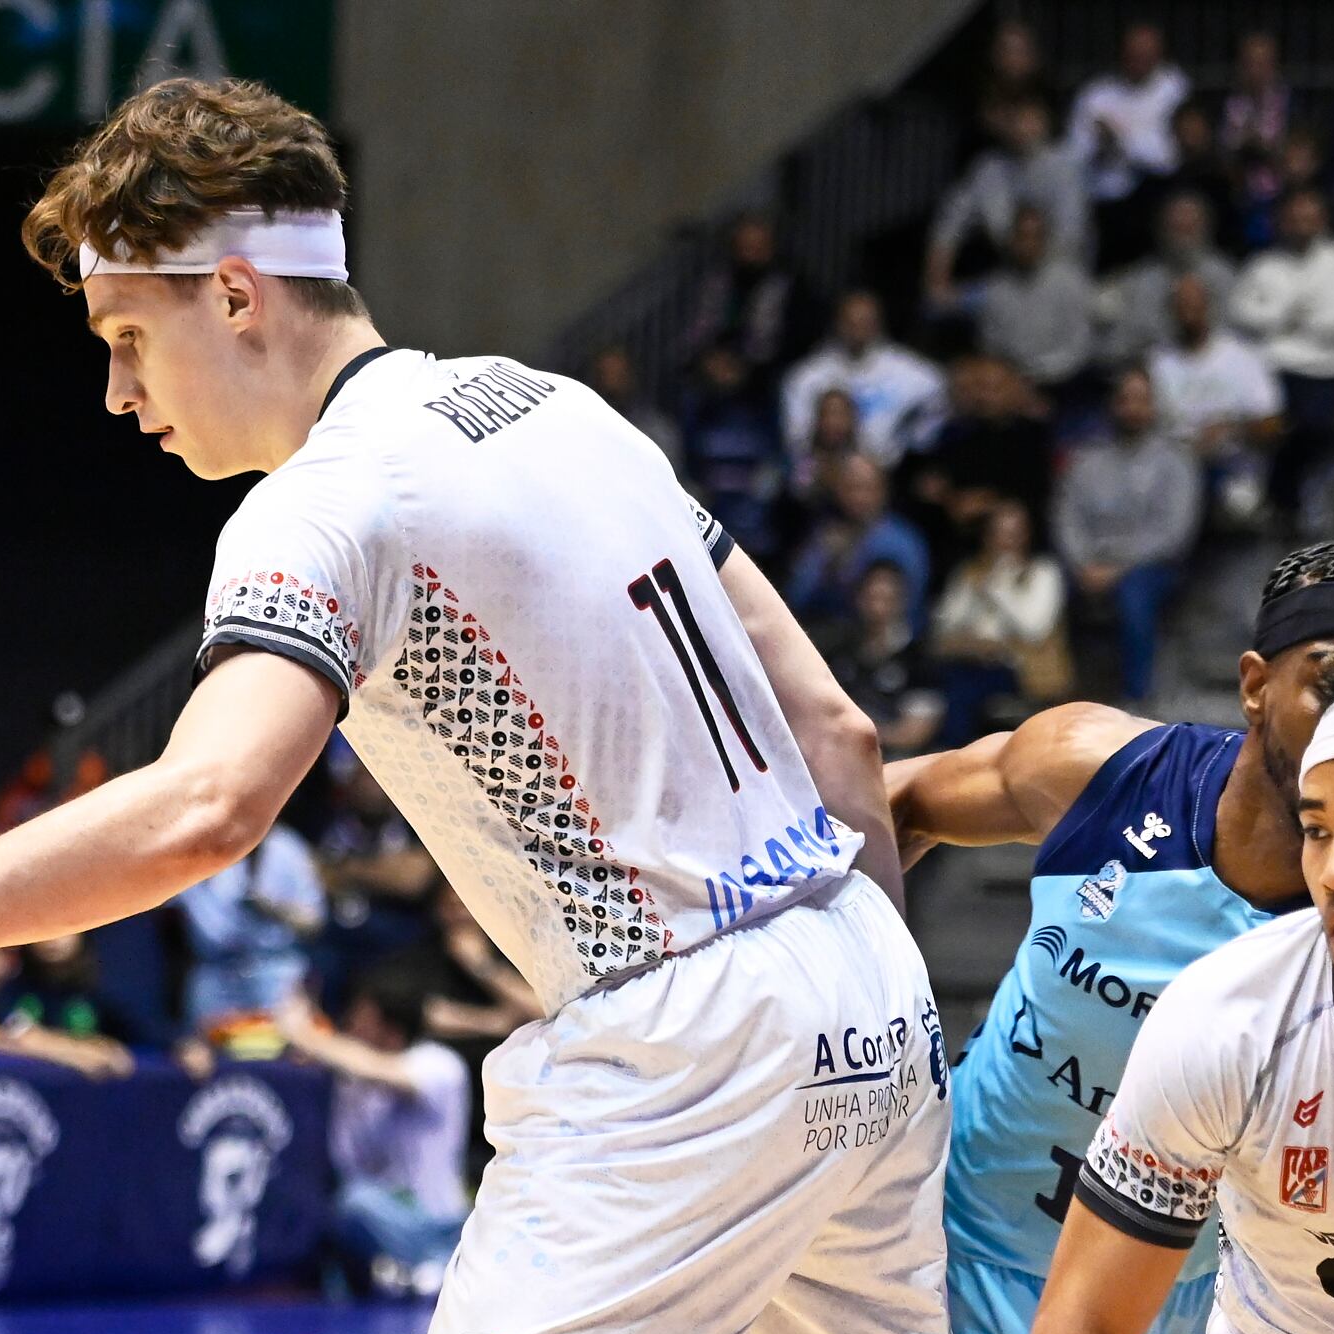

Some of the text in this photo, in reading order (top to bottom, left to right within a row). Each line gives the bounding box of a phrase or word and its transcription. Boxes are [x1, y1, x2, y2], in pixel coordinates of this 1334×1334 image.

[628, 557, 768, 794] 11
[813, 1033, 836, 1077] A
[804, 1093, 862, 1124] UNHA
[803, 1124, 847, 1152] POR
